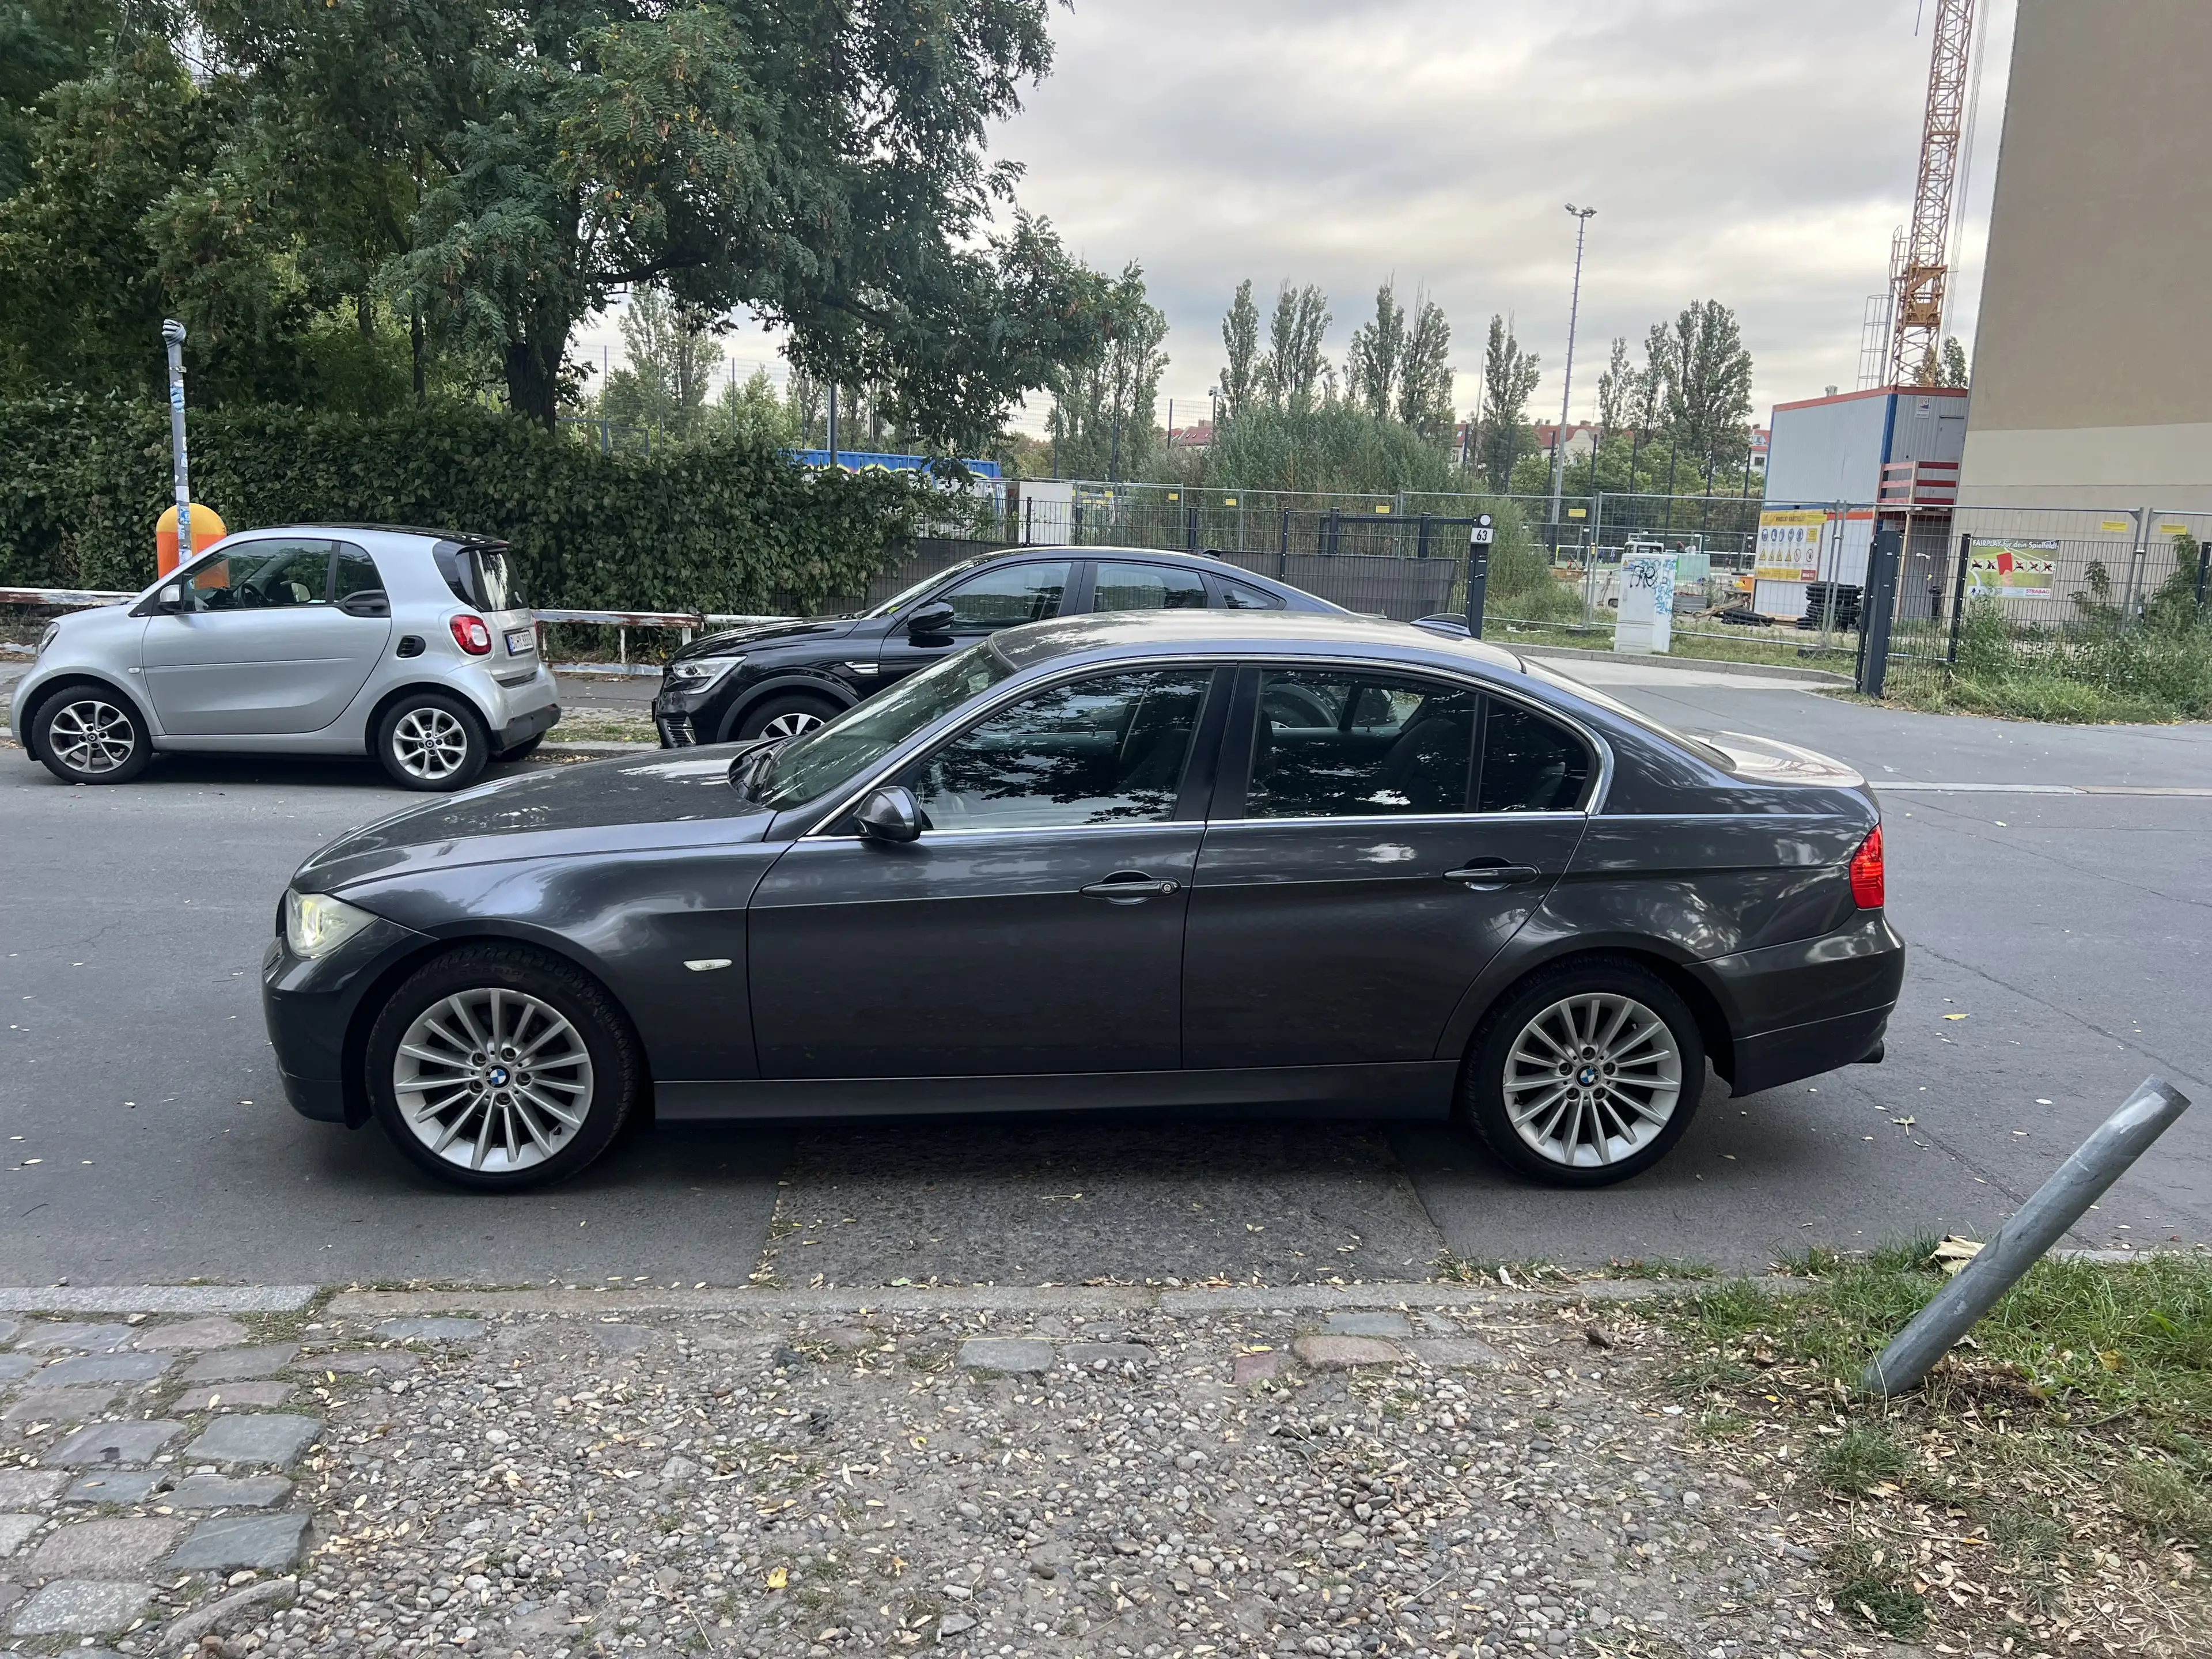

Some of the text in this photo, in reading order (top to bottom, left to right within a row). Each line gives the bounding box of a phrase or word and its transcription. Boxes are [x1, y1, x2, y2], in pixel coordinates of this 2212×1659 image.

[1476, 529, 1487, 541] 63
[2003, 540, 2012, 548] für
[2028, 541, 2058, 550] Spielfeld!
